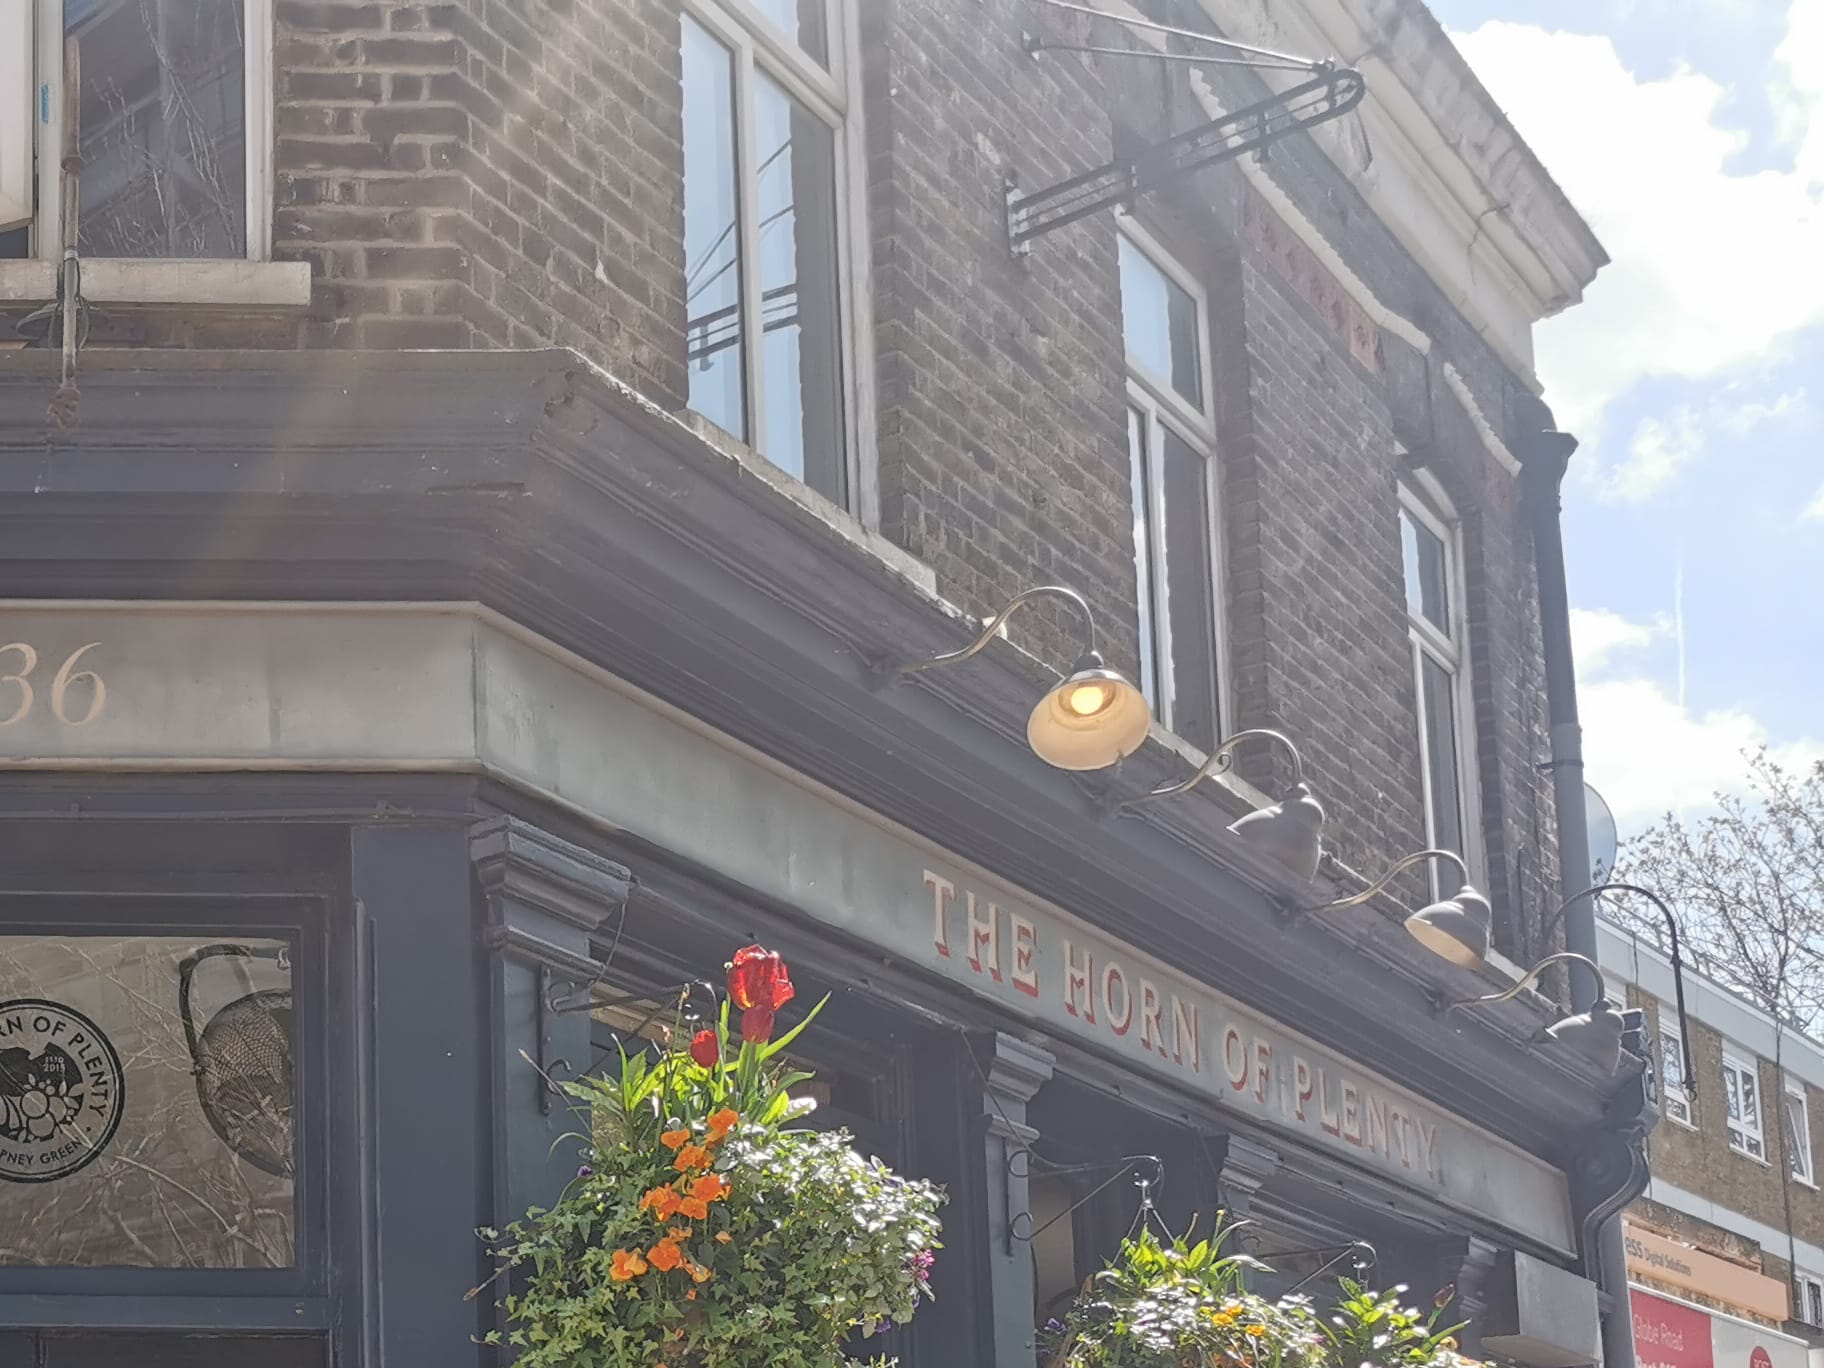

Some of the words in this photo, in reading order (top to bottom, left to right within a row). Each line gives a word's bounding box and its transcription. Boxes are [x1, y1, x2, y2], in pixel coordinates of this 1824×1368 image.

[922, 869, 1040, 998] THE
[1063, 939, 1200, 1073] HORN
[1221, 1022, 1273, 1104] OF
[1292, 1055, 1444, 1185] PLENTY
[32, 1015, 67, 1037] OF
[67, 1032, 108, 1118] PLENTY
[39, 1137, 83, 1165] GREEN
[1660, 1321, 1684, 1352] Road
